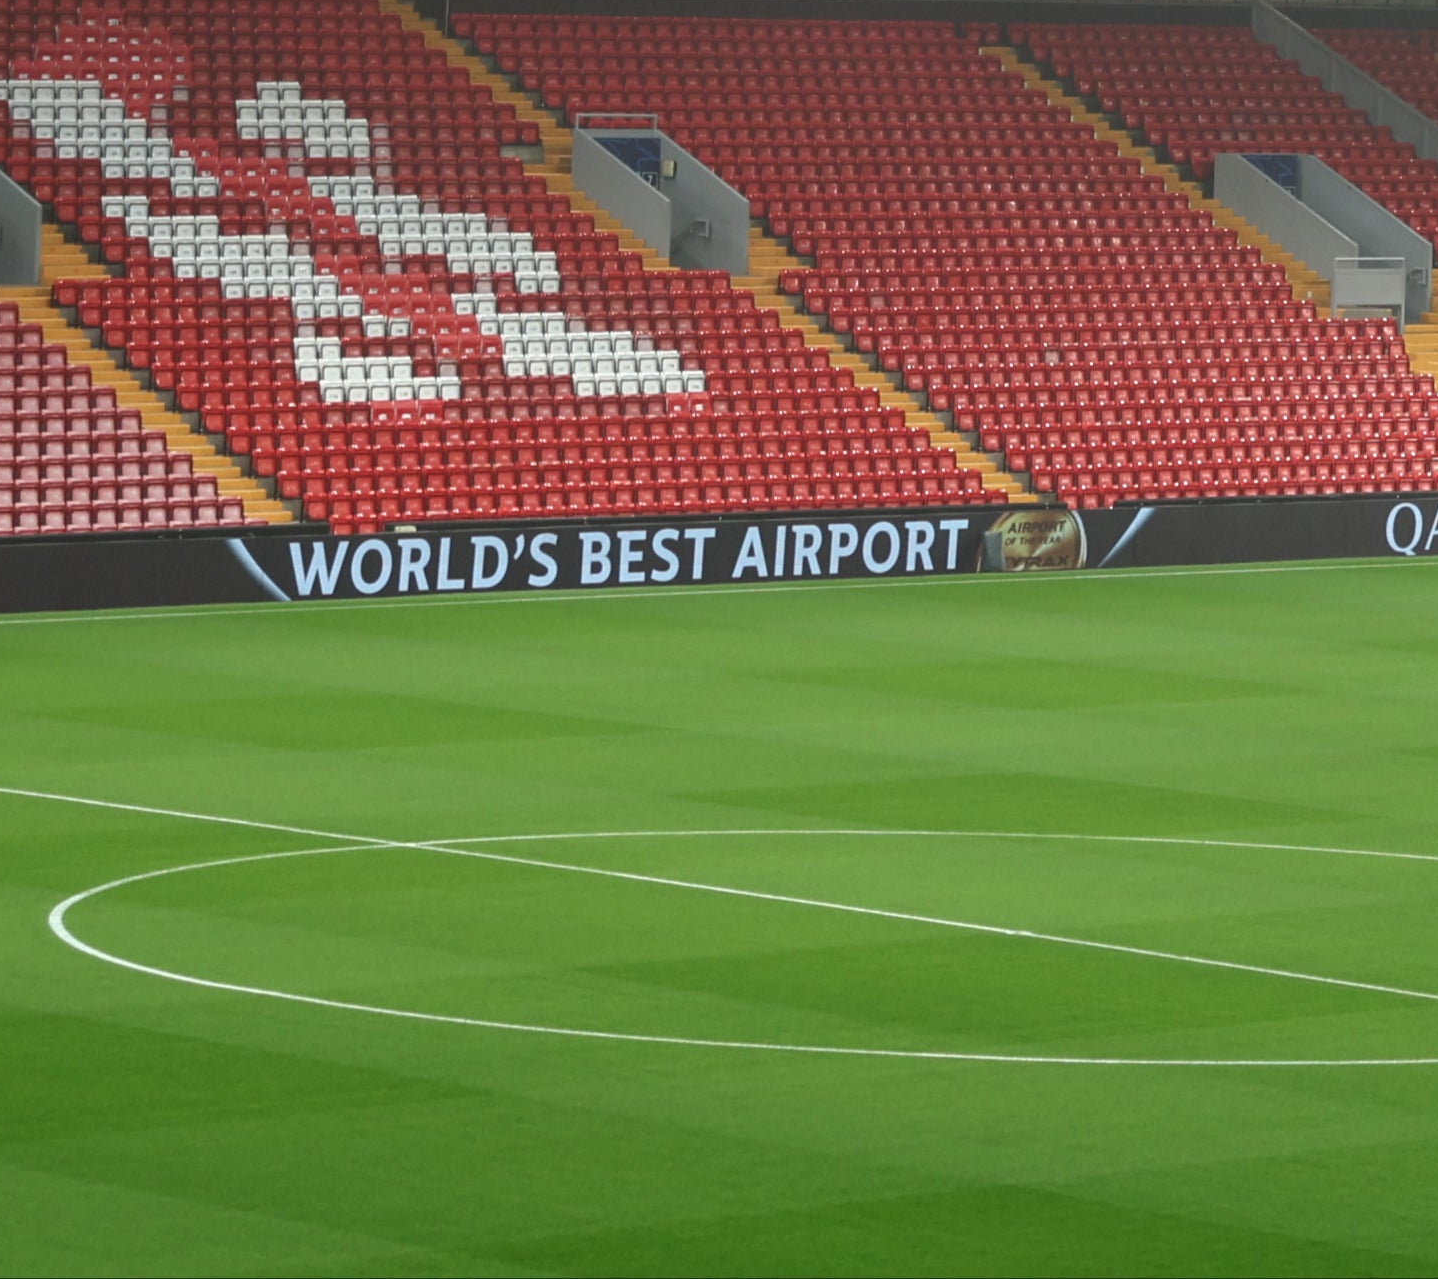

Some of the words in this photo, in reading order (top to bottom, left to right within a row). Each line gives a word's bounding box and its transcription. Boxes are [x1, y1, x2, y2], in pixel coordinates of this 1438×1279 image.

[1007, 520, 1065, 534] AIRPORT
[1004, 537, 1016, 547] OF
[289, 530, 560, 597] WORLD'S
[579, 526, 716, 585] BEST
[731, 517, 970, 579] AIRPORT
